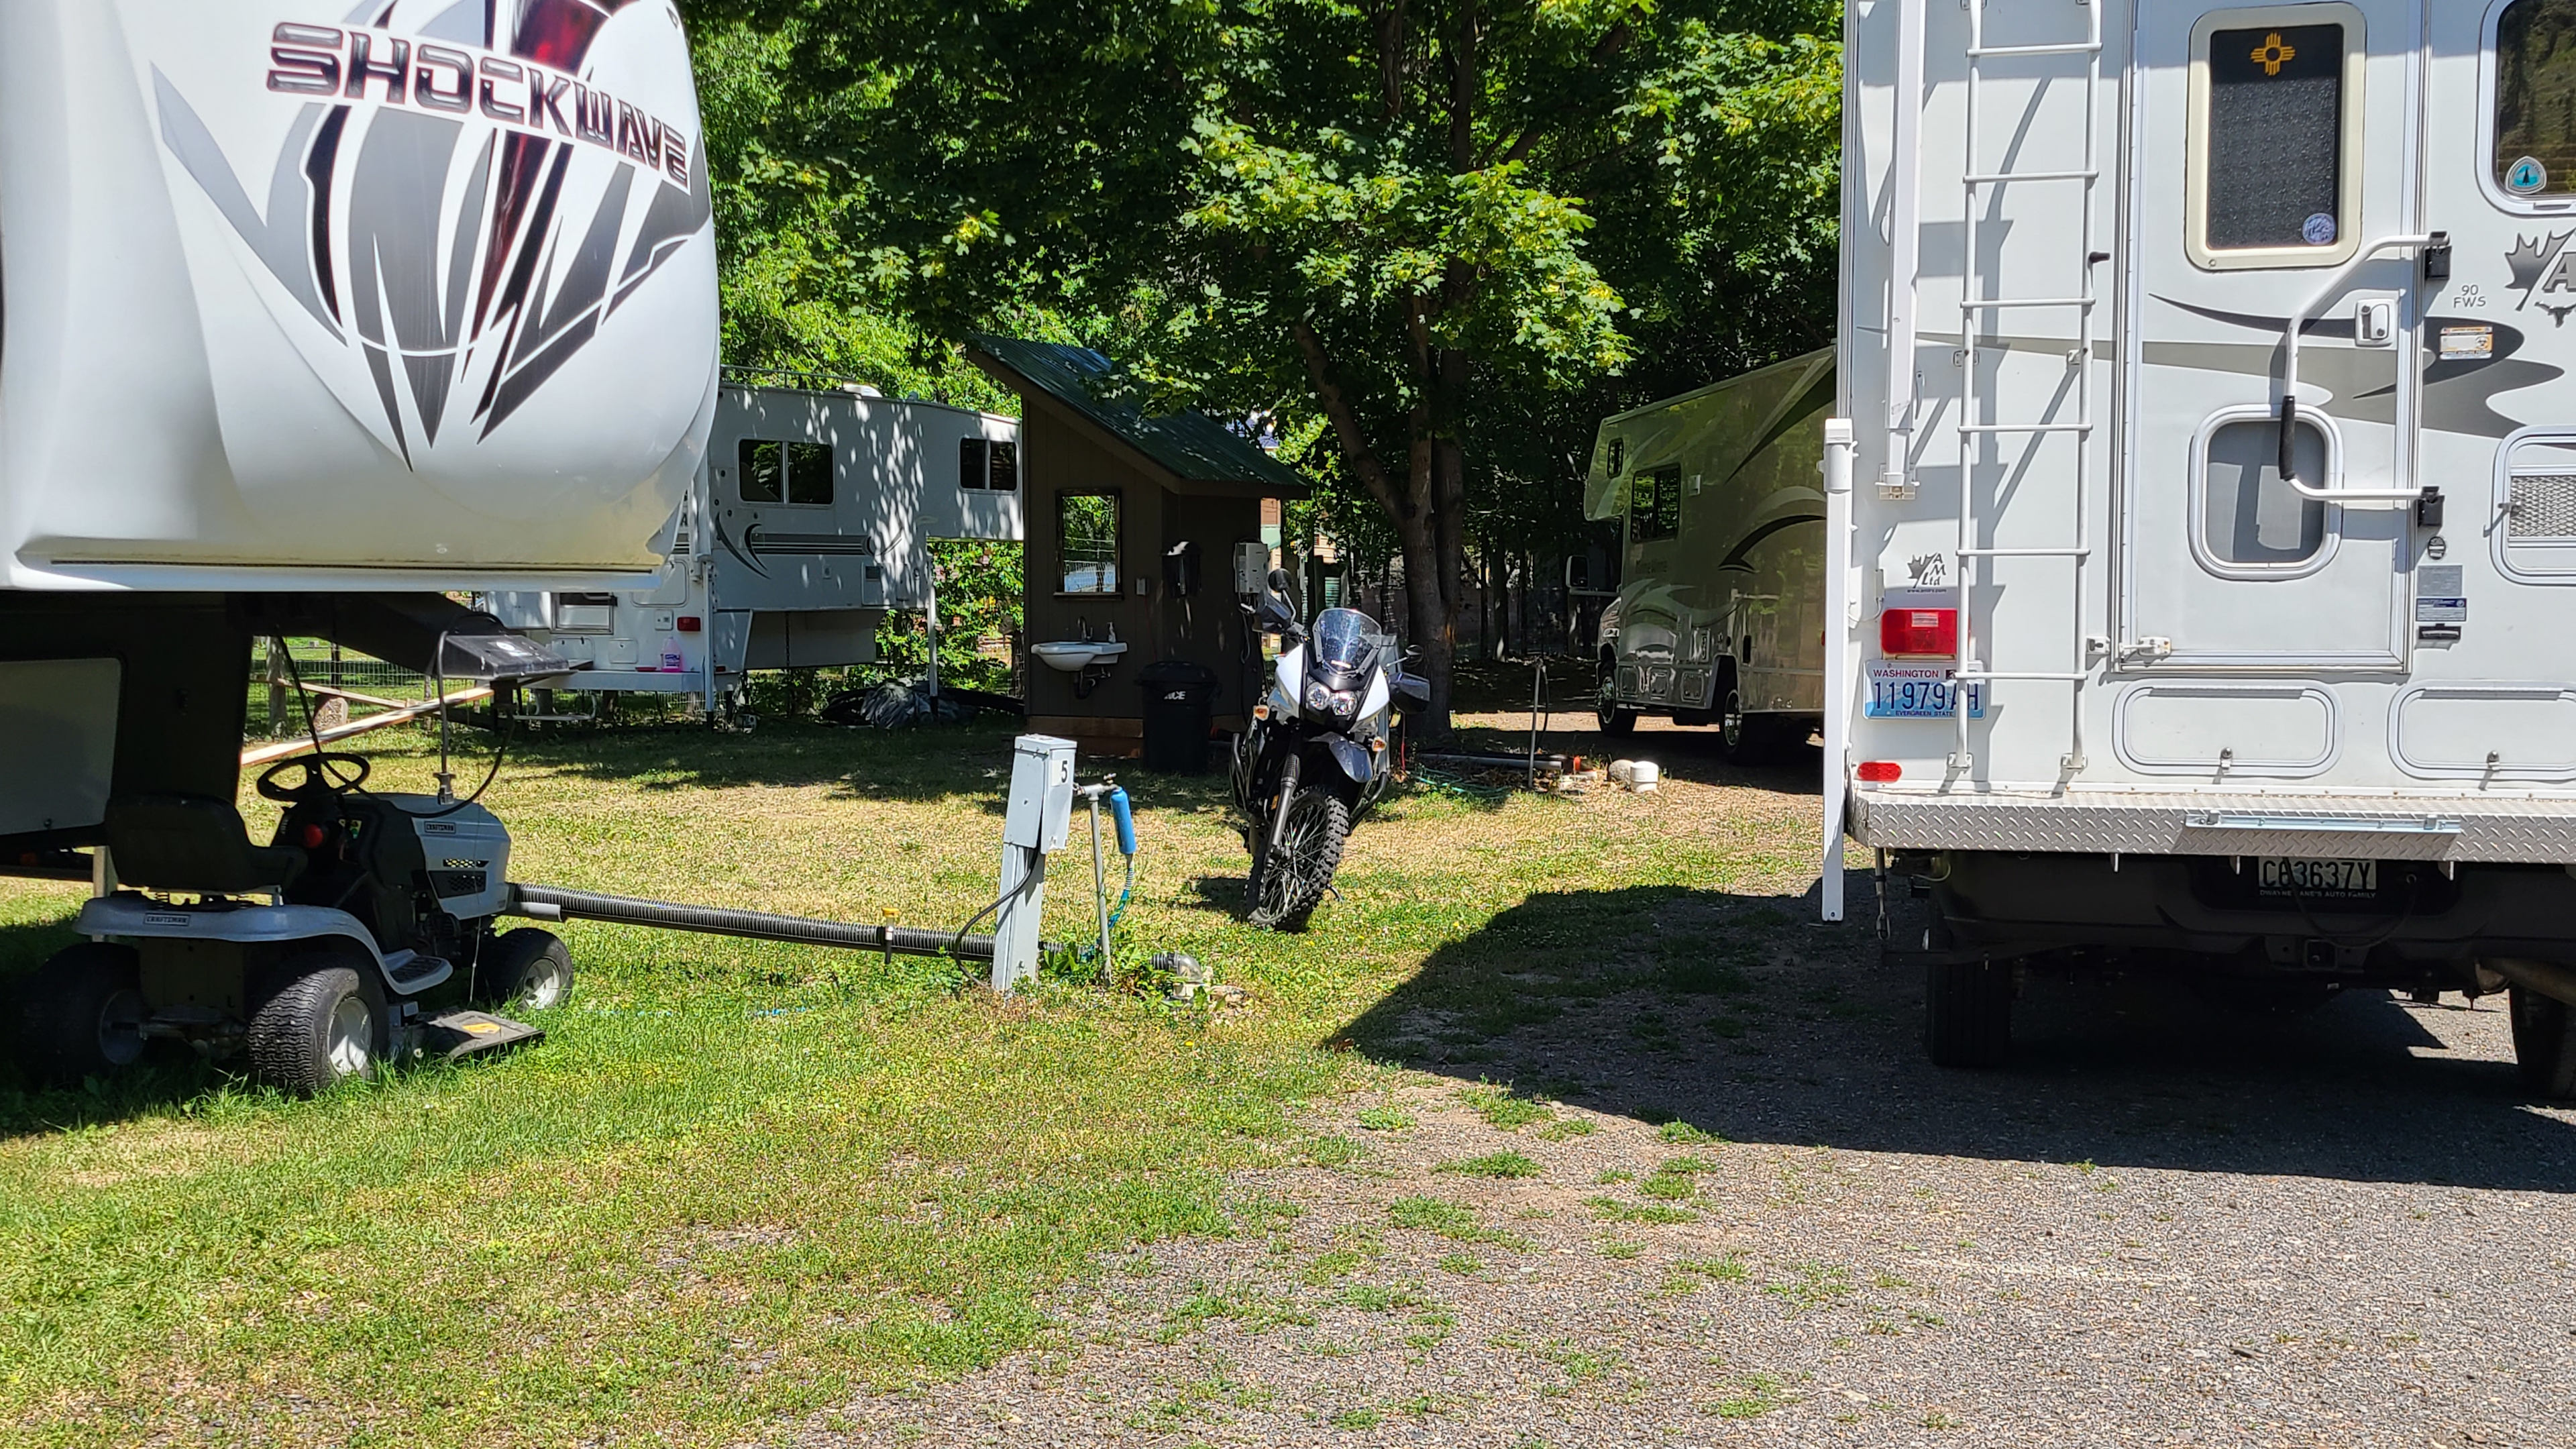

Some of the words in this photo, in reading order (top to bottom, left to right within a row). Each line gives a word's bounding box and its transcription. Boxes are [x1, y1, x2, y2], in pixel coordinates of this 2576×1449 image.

[267, 21, 689, 189] SHOCKWAVE
[2461, 284, 2479, 296] 90
[2453, 296, 2486, 309] FWS
[1873, 669, 1939, 678] WASHINGTON
[1061, 759, 1068, 784] 5
